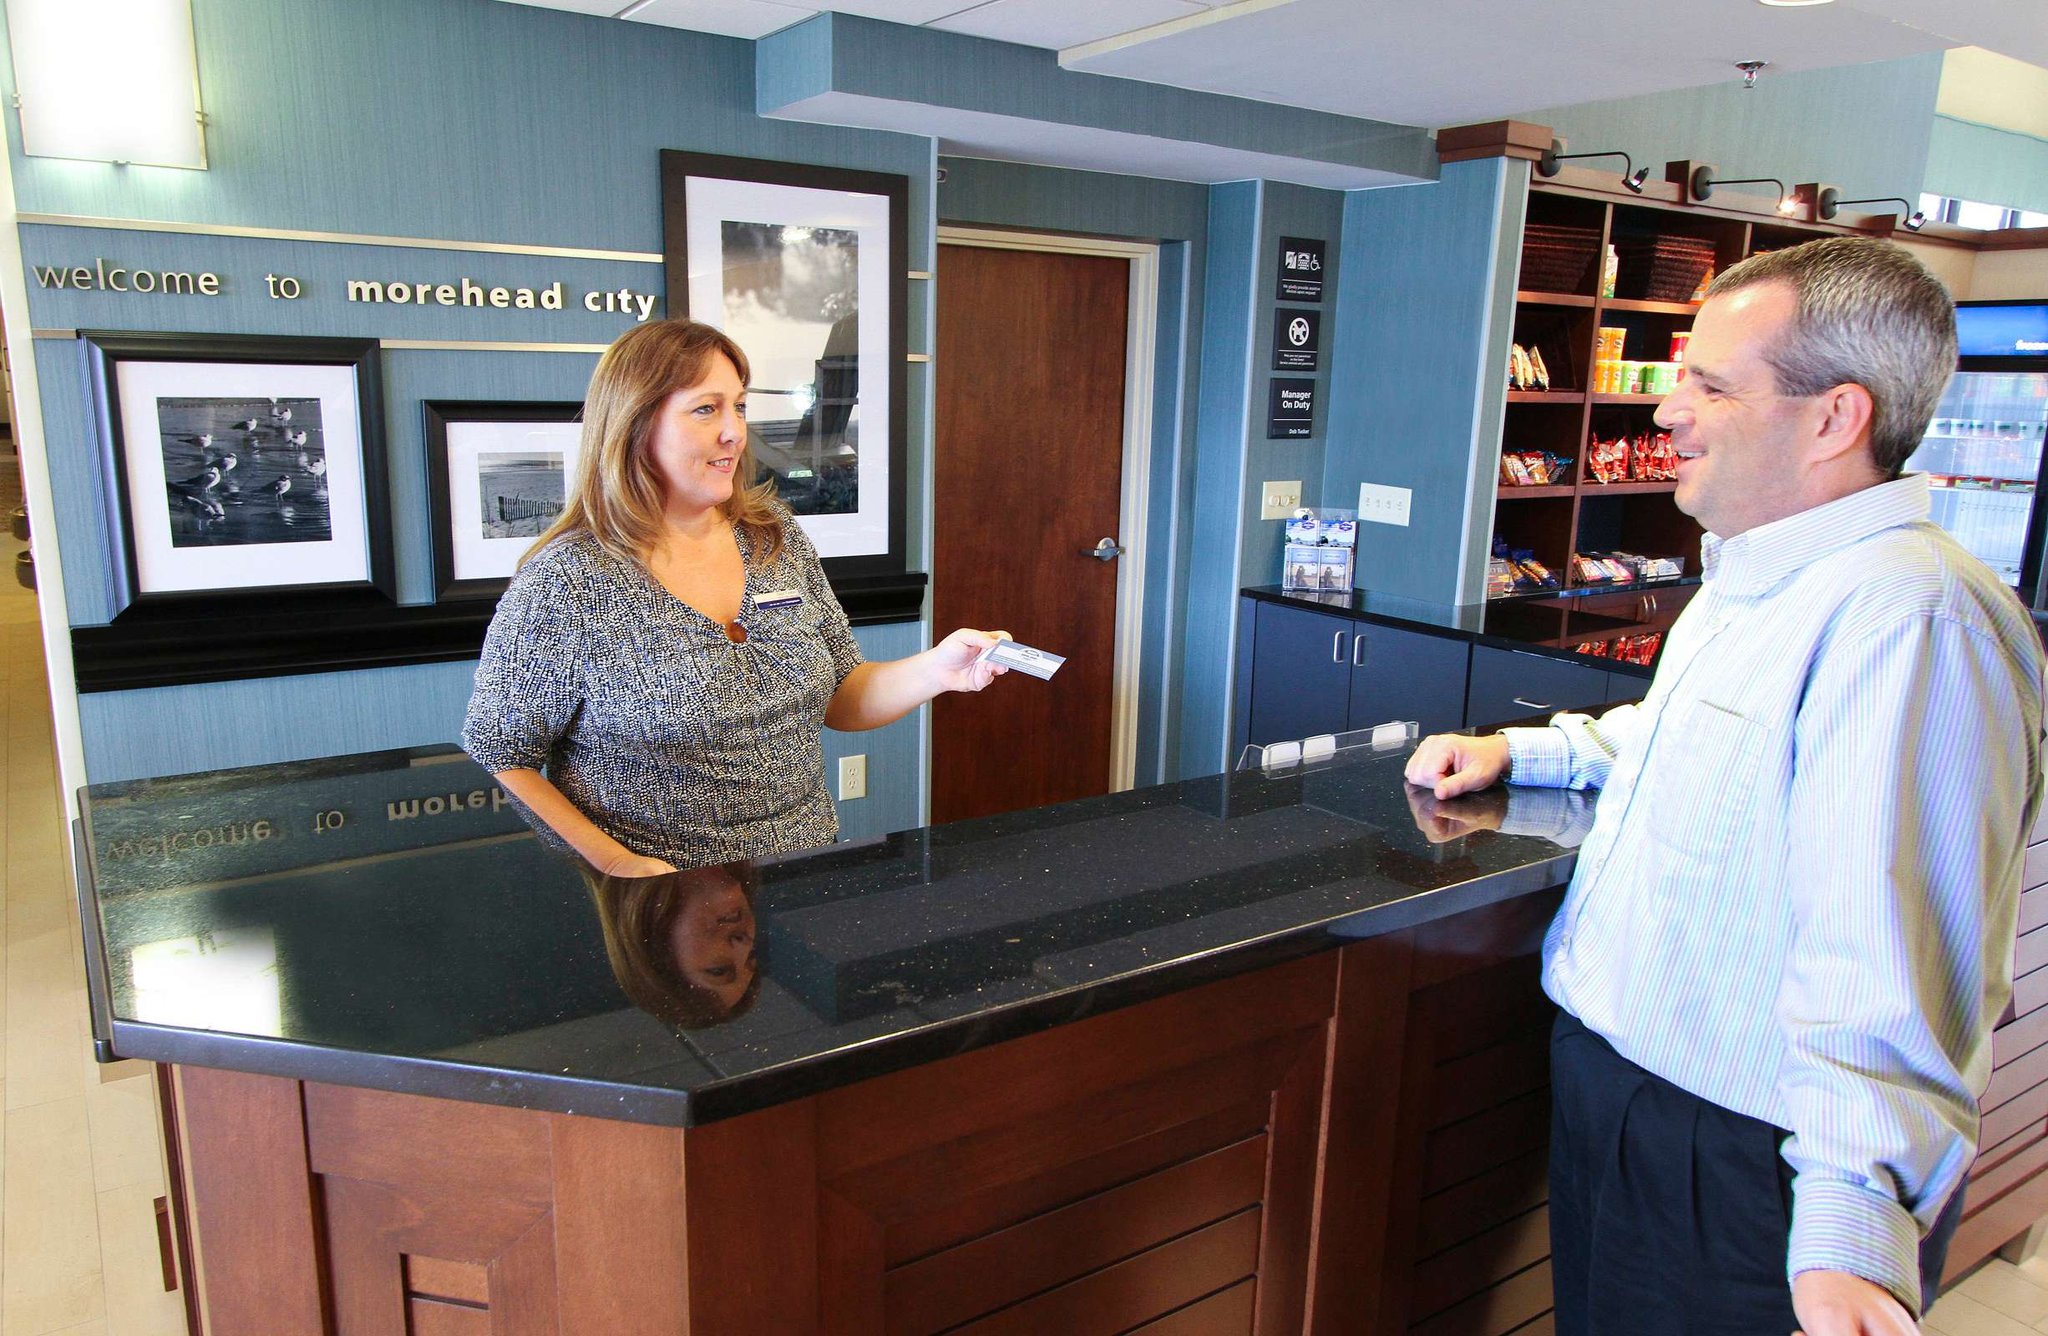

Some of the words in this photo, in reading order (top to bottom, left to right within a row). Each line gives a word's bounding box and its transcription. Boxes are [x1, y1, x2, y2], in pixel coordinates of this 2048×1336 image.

[31, 257, 219, 296] welcome
[264, 273, 301, 299] to
[347, 278, 563, 310] morehead
[584, 288, 656, 322] city
[1281, 390, 1311, 401] Manager
[1282, 400, 1293, 409] On
[1293, 400, 1311, 411] Duty
